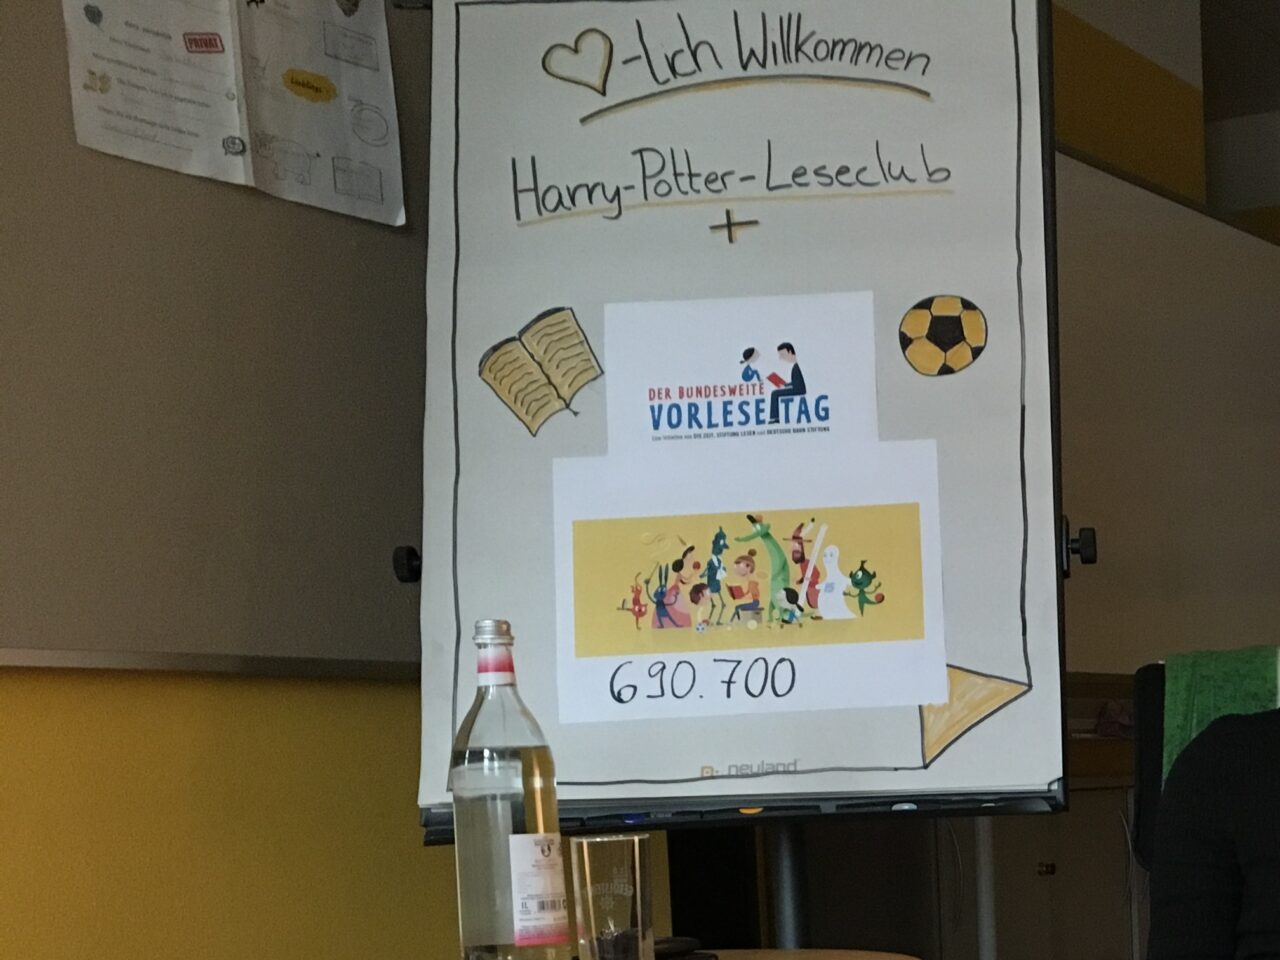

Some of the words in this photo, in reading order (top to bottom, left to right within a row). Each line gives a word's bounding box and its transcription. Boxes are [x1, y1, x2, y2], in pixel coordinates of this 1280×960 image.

[732, 9, 931, 76] Willkommen
[648, 386, 672, 401] DER
[678, 382, 765, 399] BUNDESWEITE
[609, 656, 796, 704] 690.700
[728, 758, 798, 776] neuland
